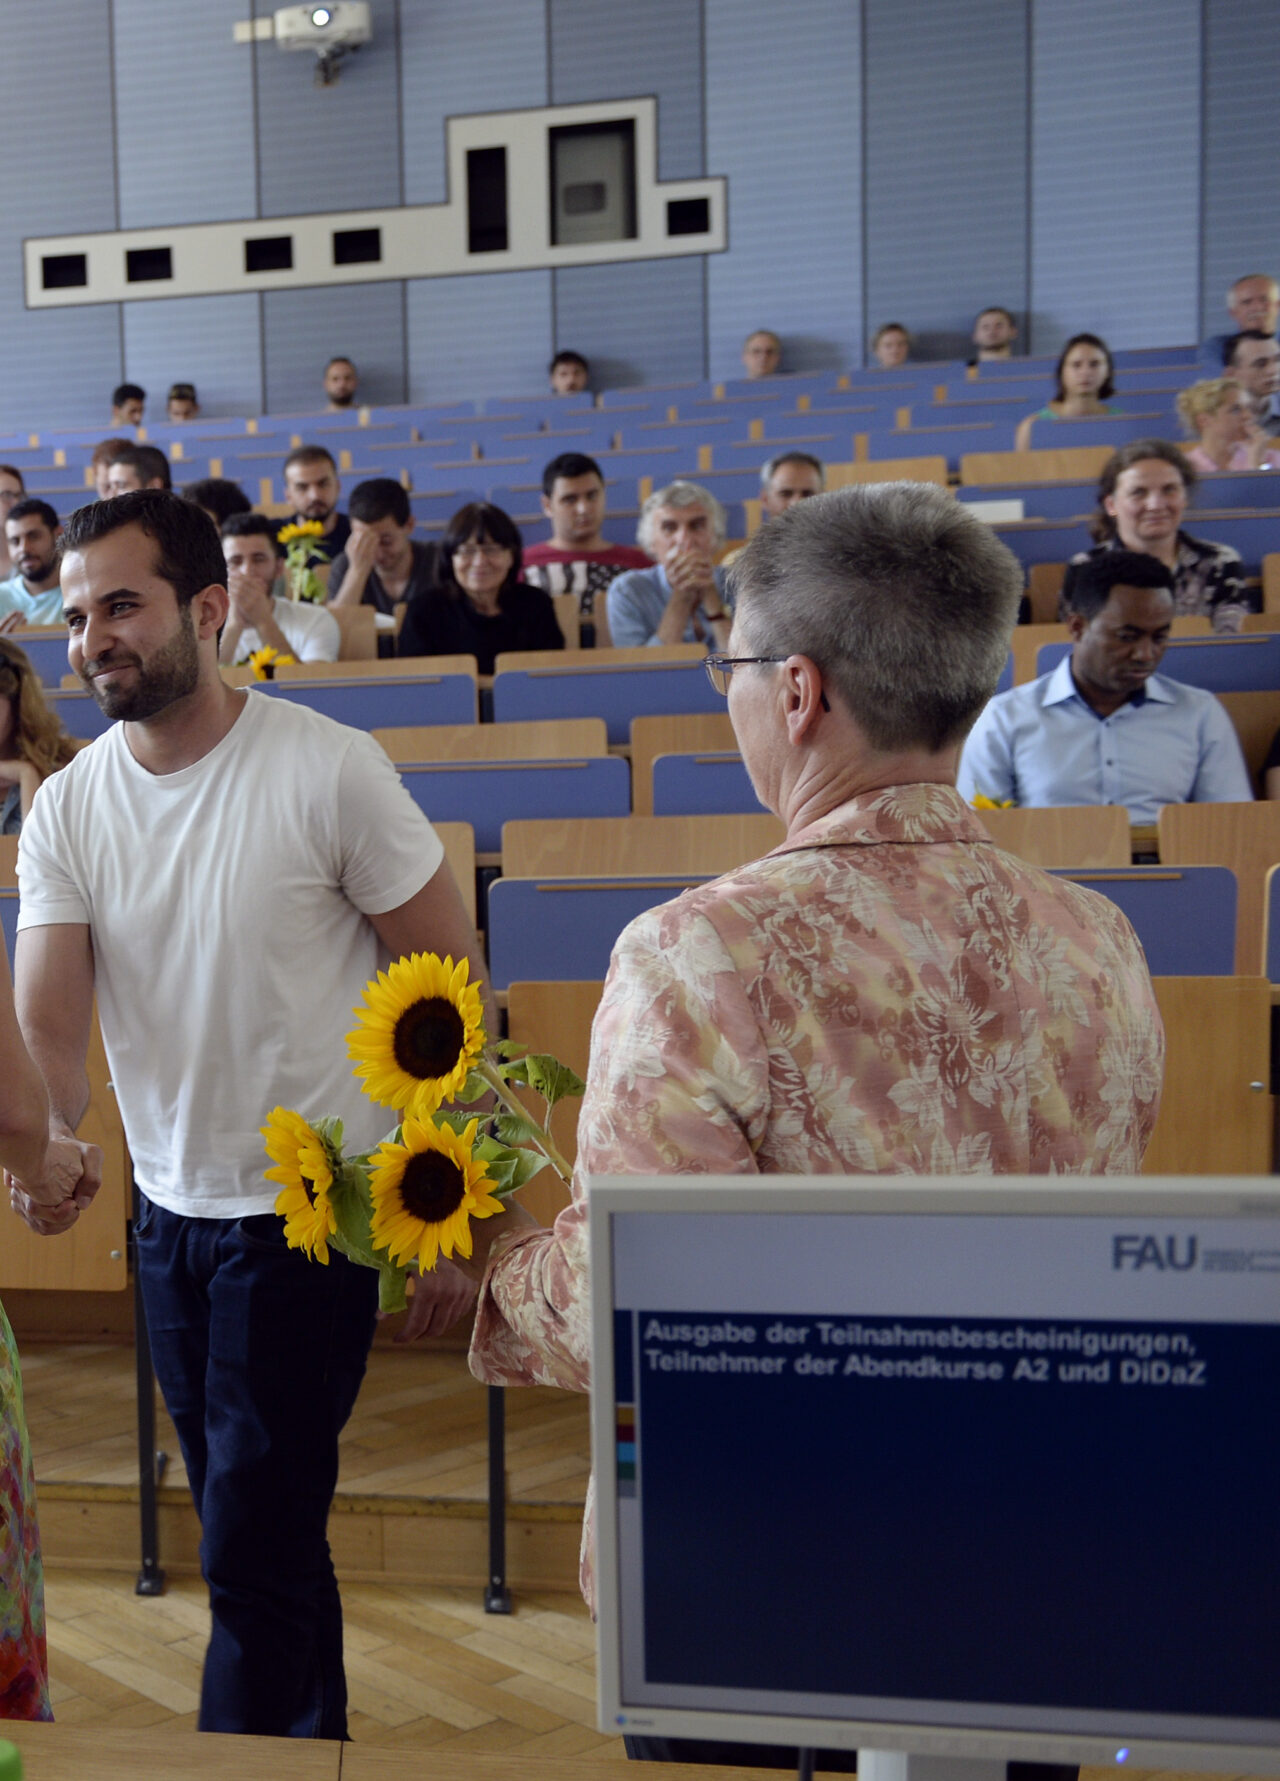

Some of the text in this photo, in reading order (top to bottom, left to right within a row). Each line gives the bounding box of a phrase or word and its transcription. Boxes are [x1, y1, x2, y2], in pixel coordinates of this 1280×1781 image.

[1113, 1233, 1198, 1272] FAU
[644, 1319, 1197, 1358] Ausgabe der Teilnahmebescheinigungen,
[645, 1349, 787, 1374] Teilnehmer
[794, 1353, 839, 1376] der
[843, 1353, 1005, 1381] Abendkurse
[1012, 1357, 1051, 1383] A2
[1058, 1361, 1111, 1383] und
